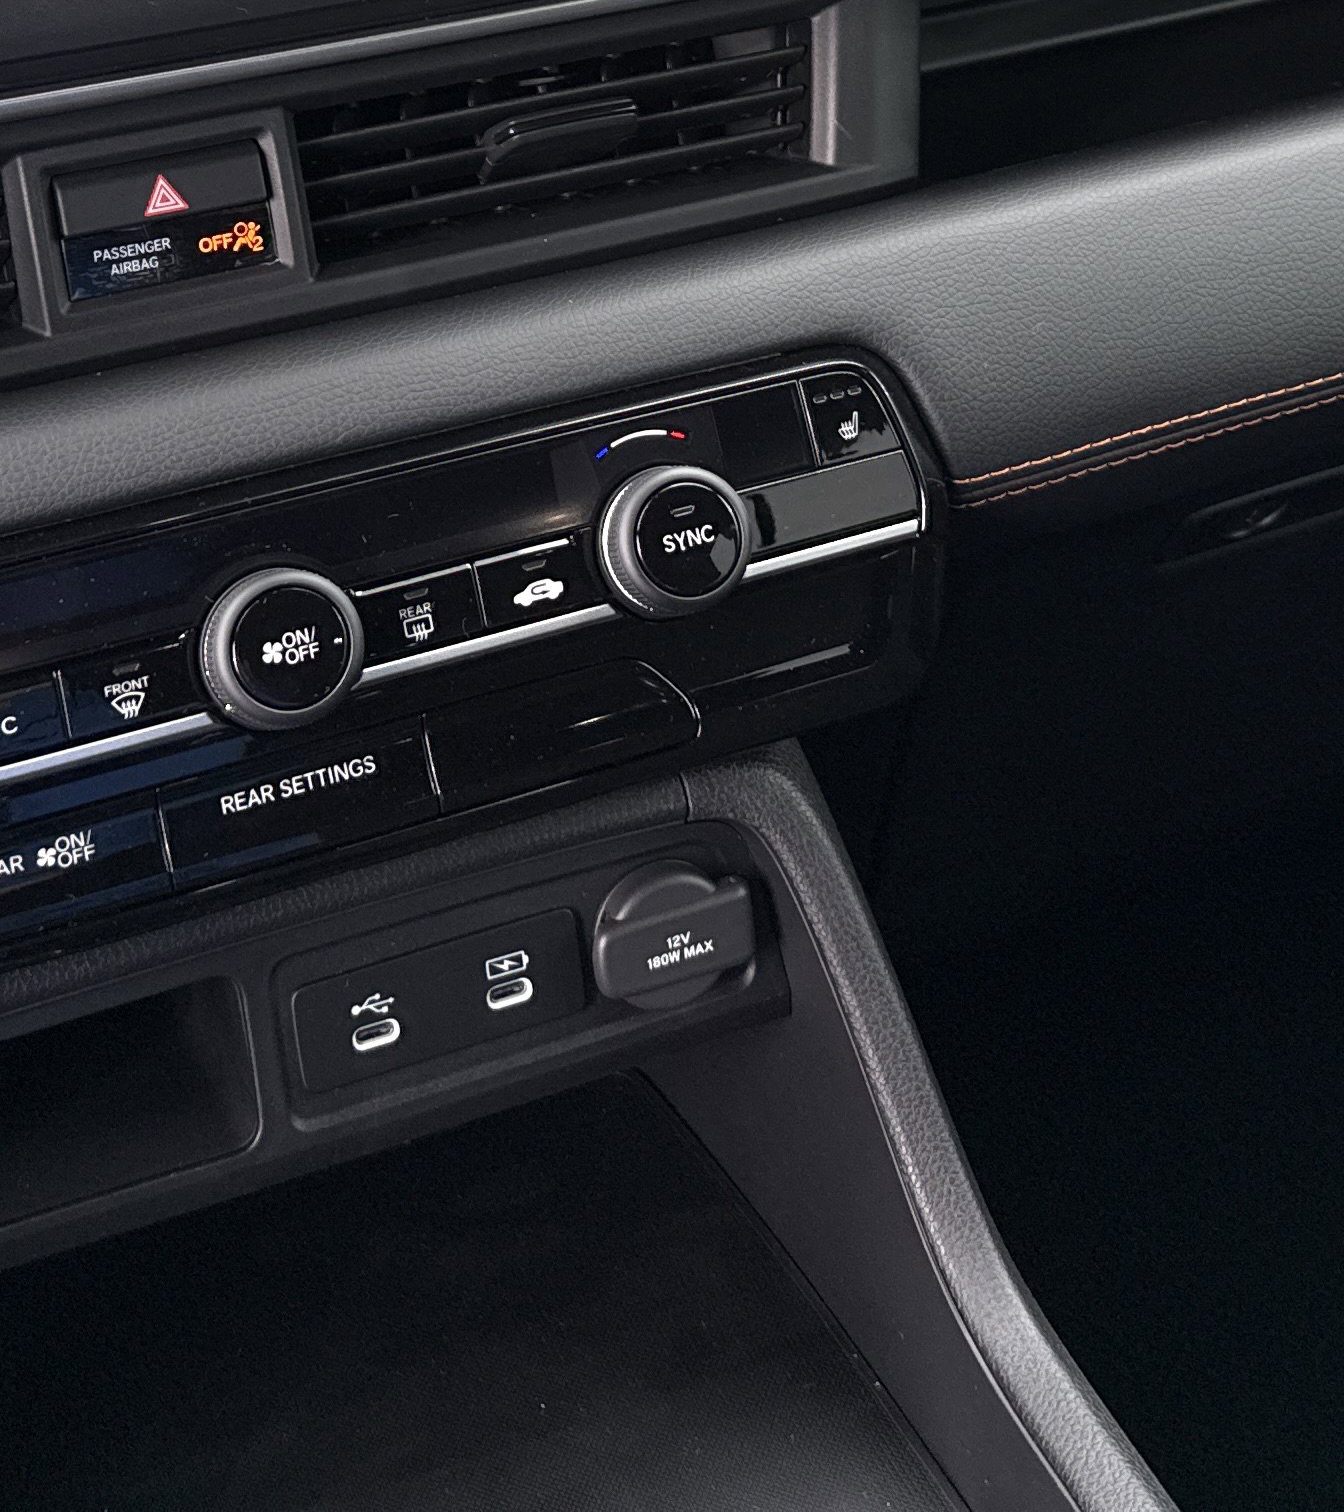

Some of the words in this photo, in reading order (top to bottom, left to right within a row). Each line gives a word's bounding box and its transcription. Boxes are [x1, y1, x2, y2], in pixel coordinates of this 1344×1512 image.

[92, 237, 172, 263] PASSENGER
[198, 232, 234, 253] OFF
[110, 255, 160, 276] AIRBAG
[662, 524, 715, 553] SYNC
[398, 601, 433, 620] REAR
[281, 625, 316, 649] ON/
[285, 641, 320, 665] OFF
[104, 675, 150, 697] FRONT
[220, 784, 276, 815] REAR
[279, 755, 377, 799] SETTINGS
[54, 829, 92, 853] ON/
[57, 843, 96, 868] OFF
[666, 930, 691, 950] 12V
[647, 948, 681, 971] 180W
[683, 939, 714, 960] MAX
